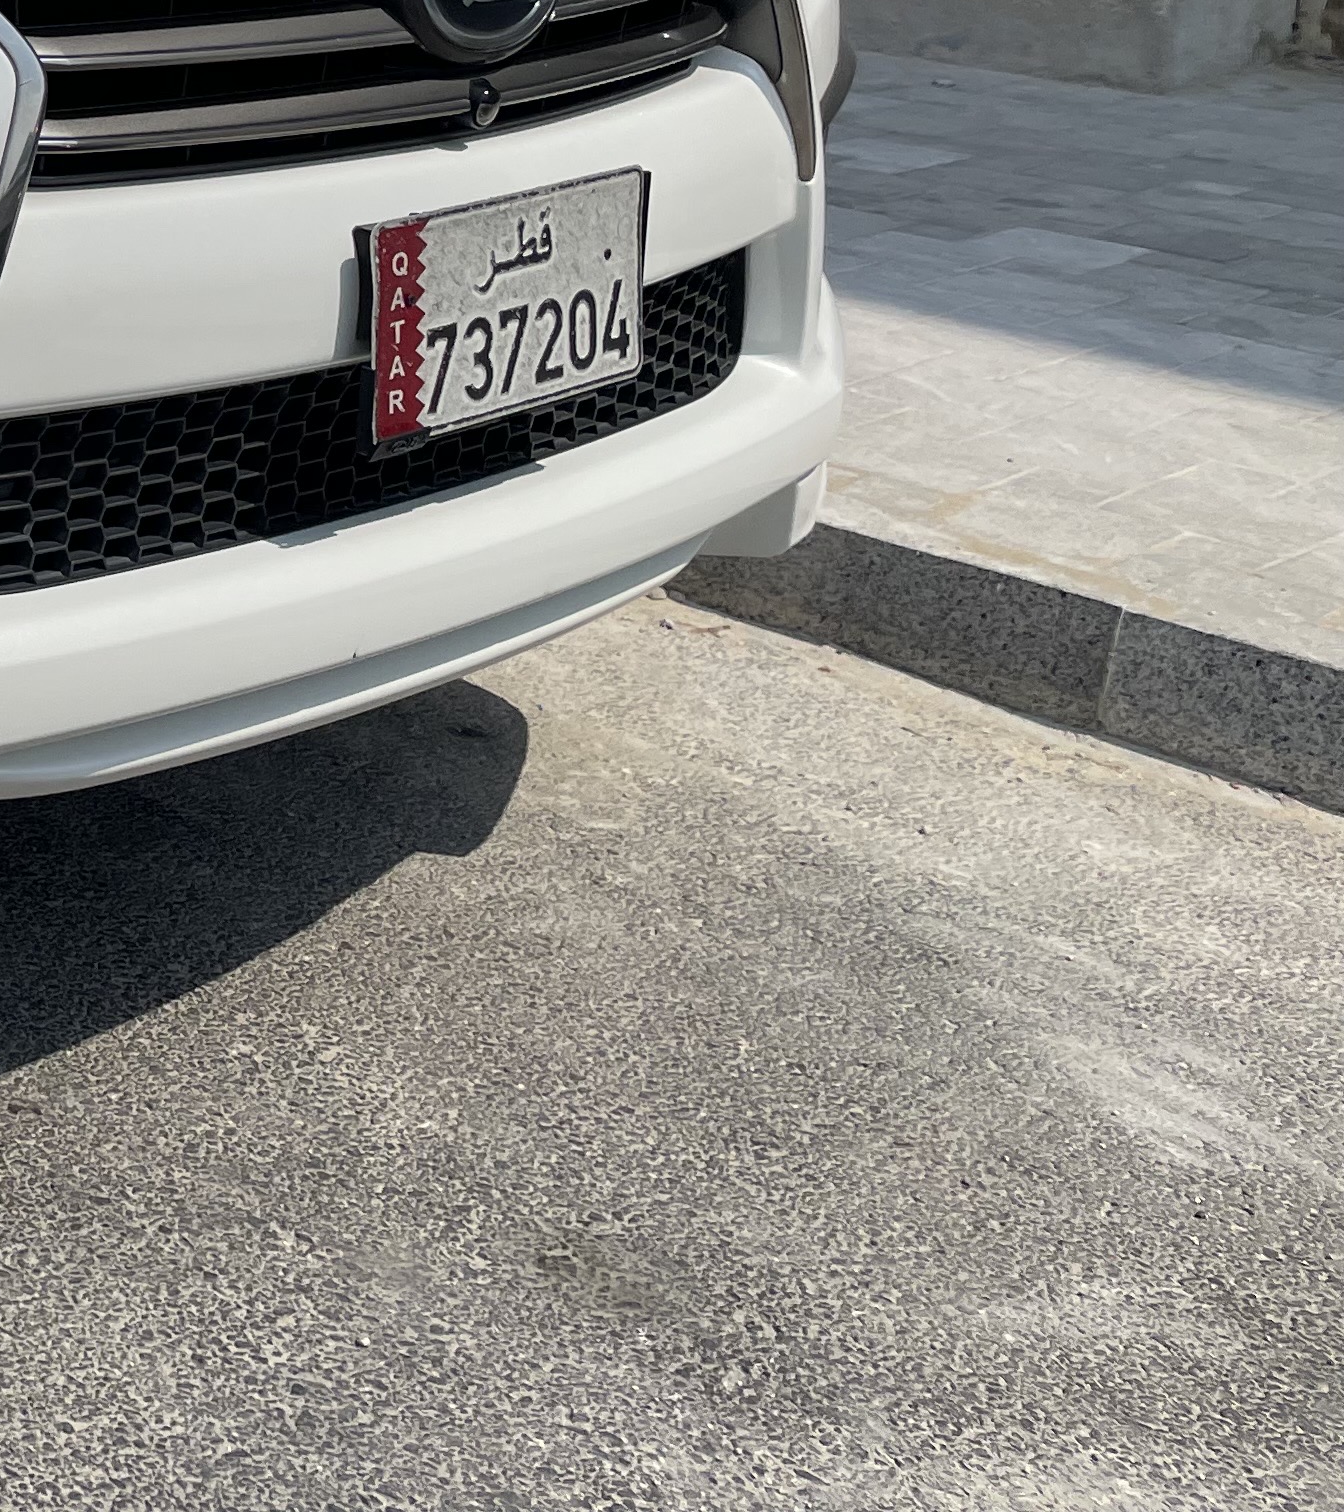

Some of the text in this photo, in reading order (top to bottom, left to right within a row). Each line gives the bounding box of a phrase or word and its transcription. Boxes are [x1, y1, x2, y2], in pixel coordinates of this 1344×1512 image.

[474, 206, 552, 295] قطر
[388, 251, 410, 414] QATAR
[426, 278, 631, 415] 737204
